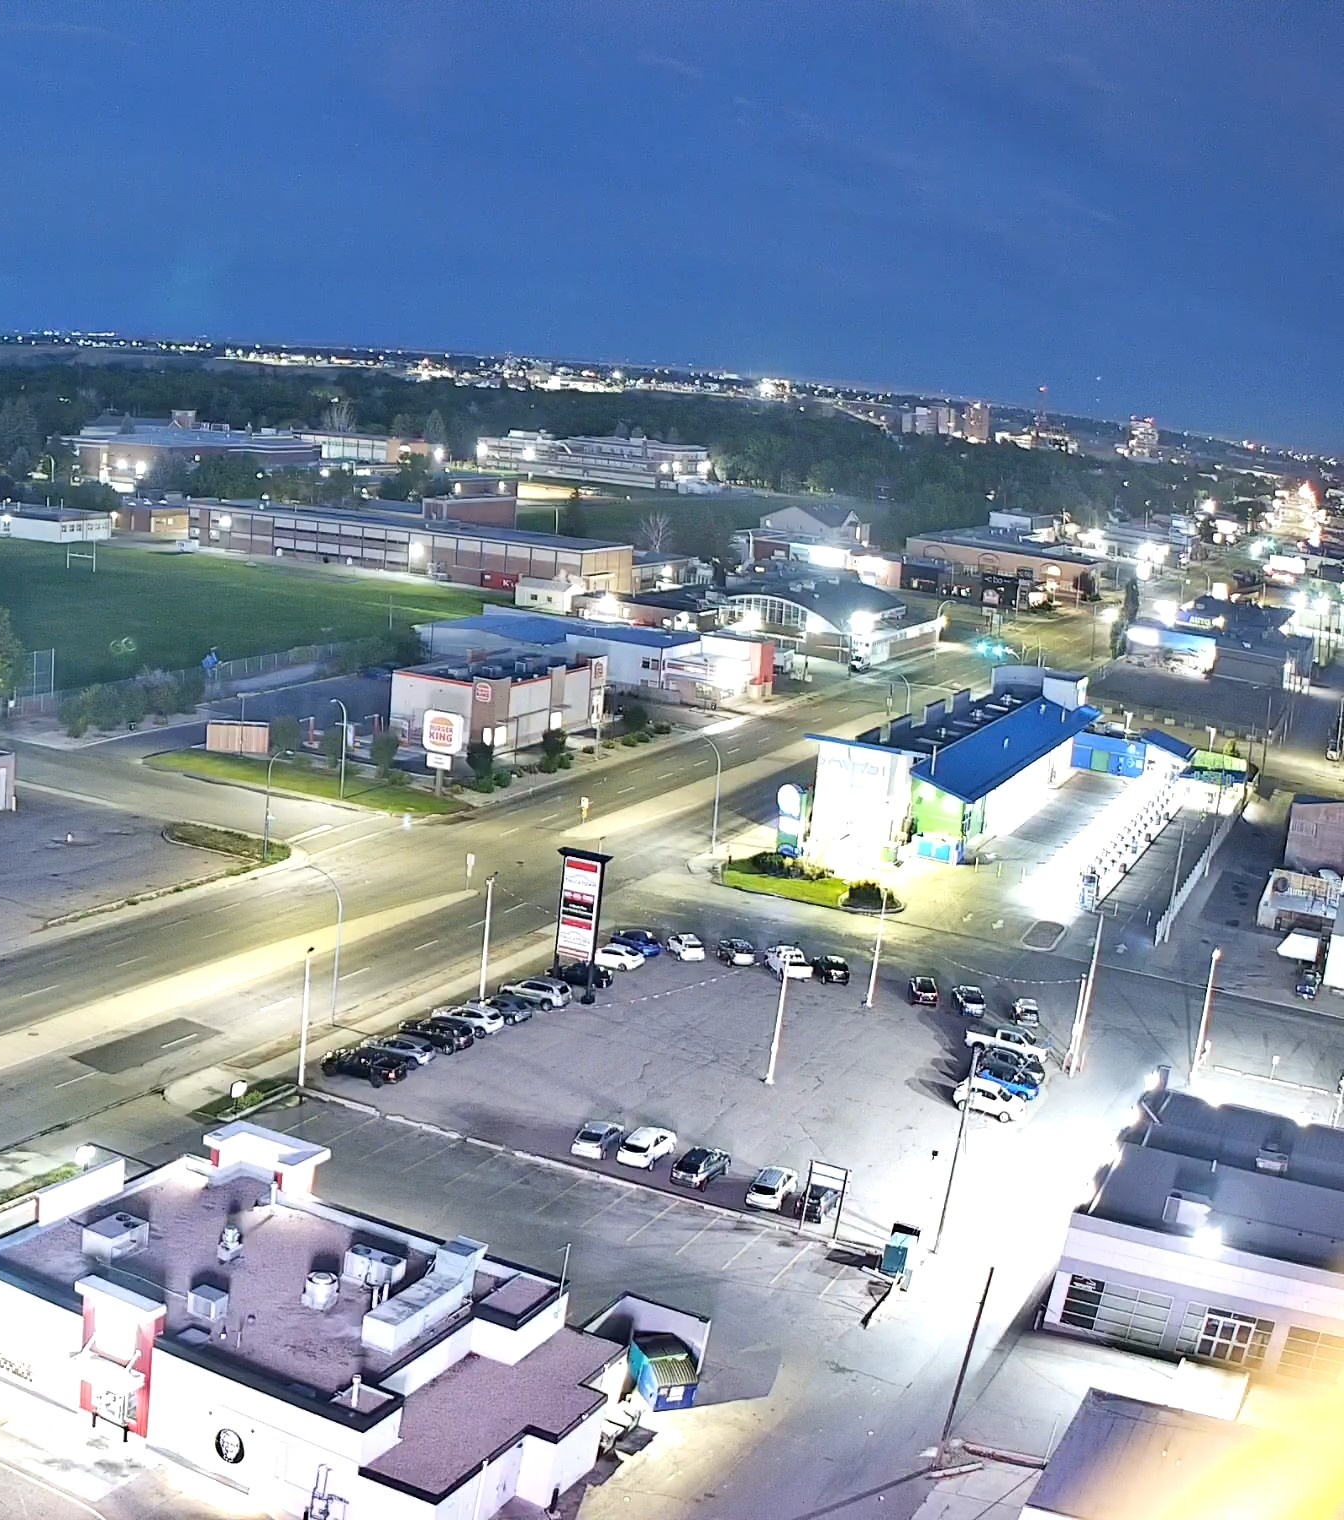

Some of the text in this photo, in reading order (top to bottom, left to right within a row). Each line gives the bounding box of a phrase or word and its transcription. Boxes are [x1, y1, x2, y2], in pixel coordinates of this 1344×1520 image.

[1189, 616, 1211, 626] AUTO
[430, 725, 453, 733] BURGER
[429, 731, 452, 742] KING
